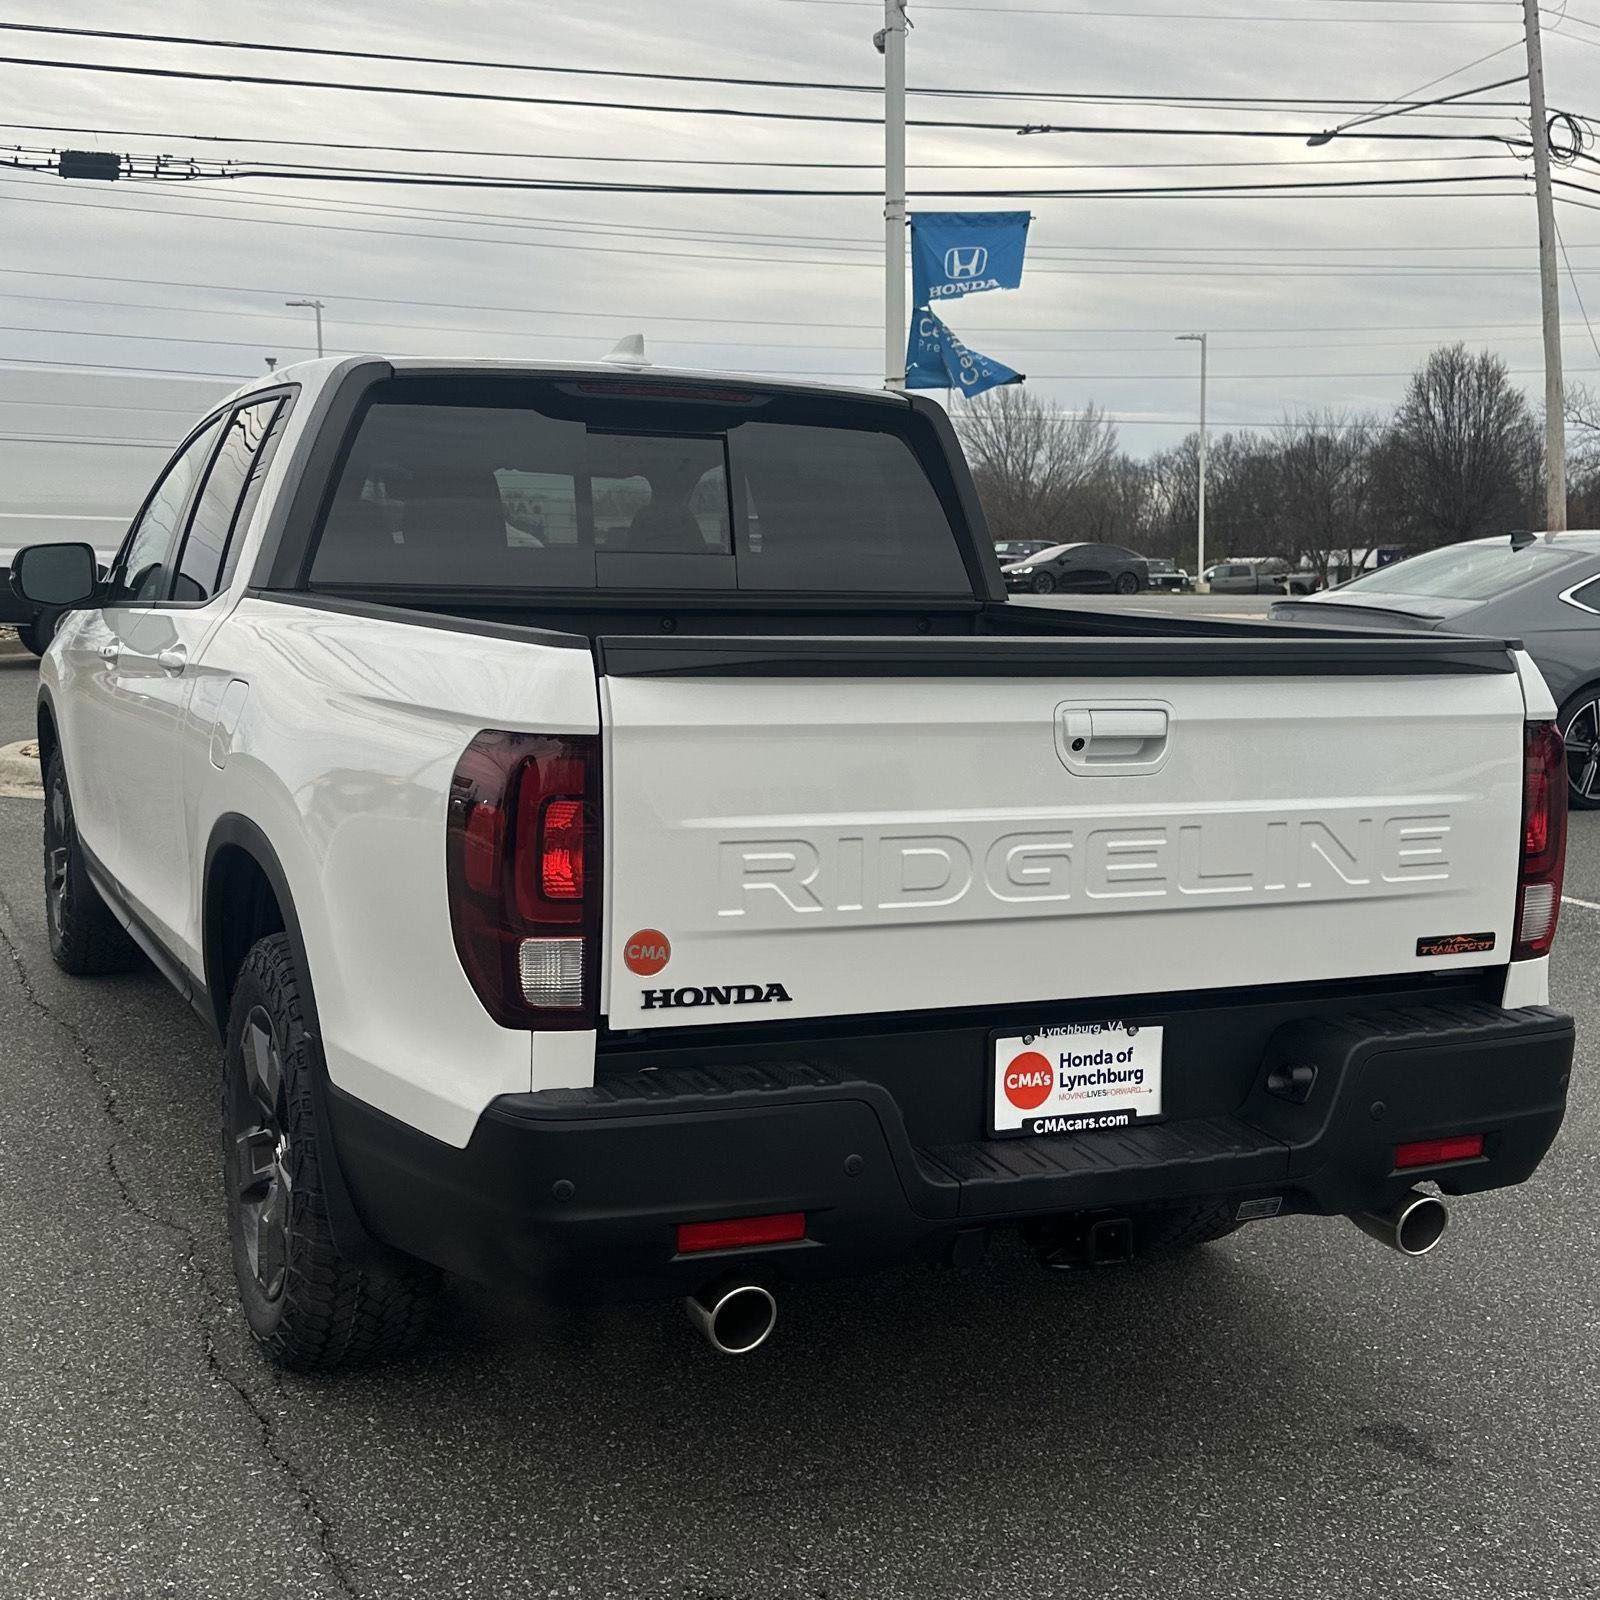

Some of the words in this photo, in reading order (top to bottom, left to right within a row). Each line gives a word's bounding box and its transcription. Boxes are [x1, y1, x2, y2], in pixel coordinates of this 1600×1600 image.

[929, 279, 1000, 298] HONDA
[718, 815, 1450, 917] RIDGELINE
[627, 945, 668, 961] CMA
[1421, 941, 1494, 955] TRAILSPORT
[641, 983, 793, 1010] HONDA
[1108, 1020, 1124, 1032] VA
[1059, 1050, 1113, 1069] Honda
[1116, 1047, 1134, 1063] of
[1006, 1071, 1051, 1090] CMA's
[1059, 1068, 1144, 1091] Lynchburg
[1033, 1114, 1128, 1134] CMAcars.com
